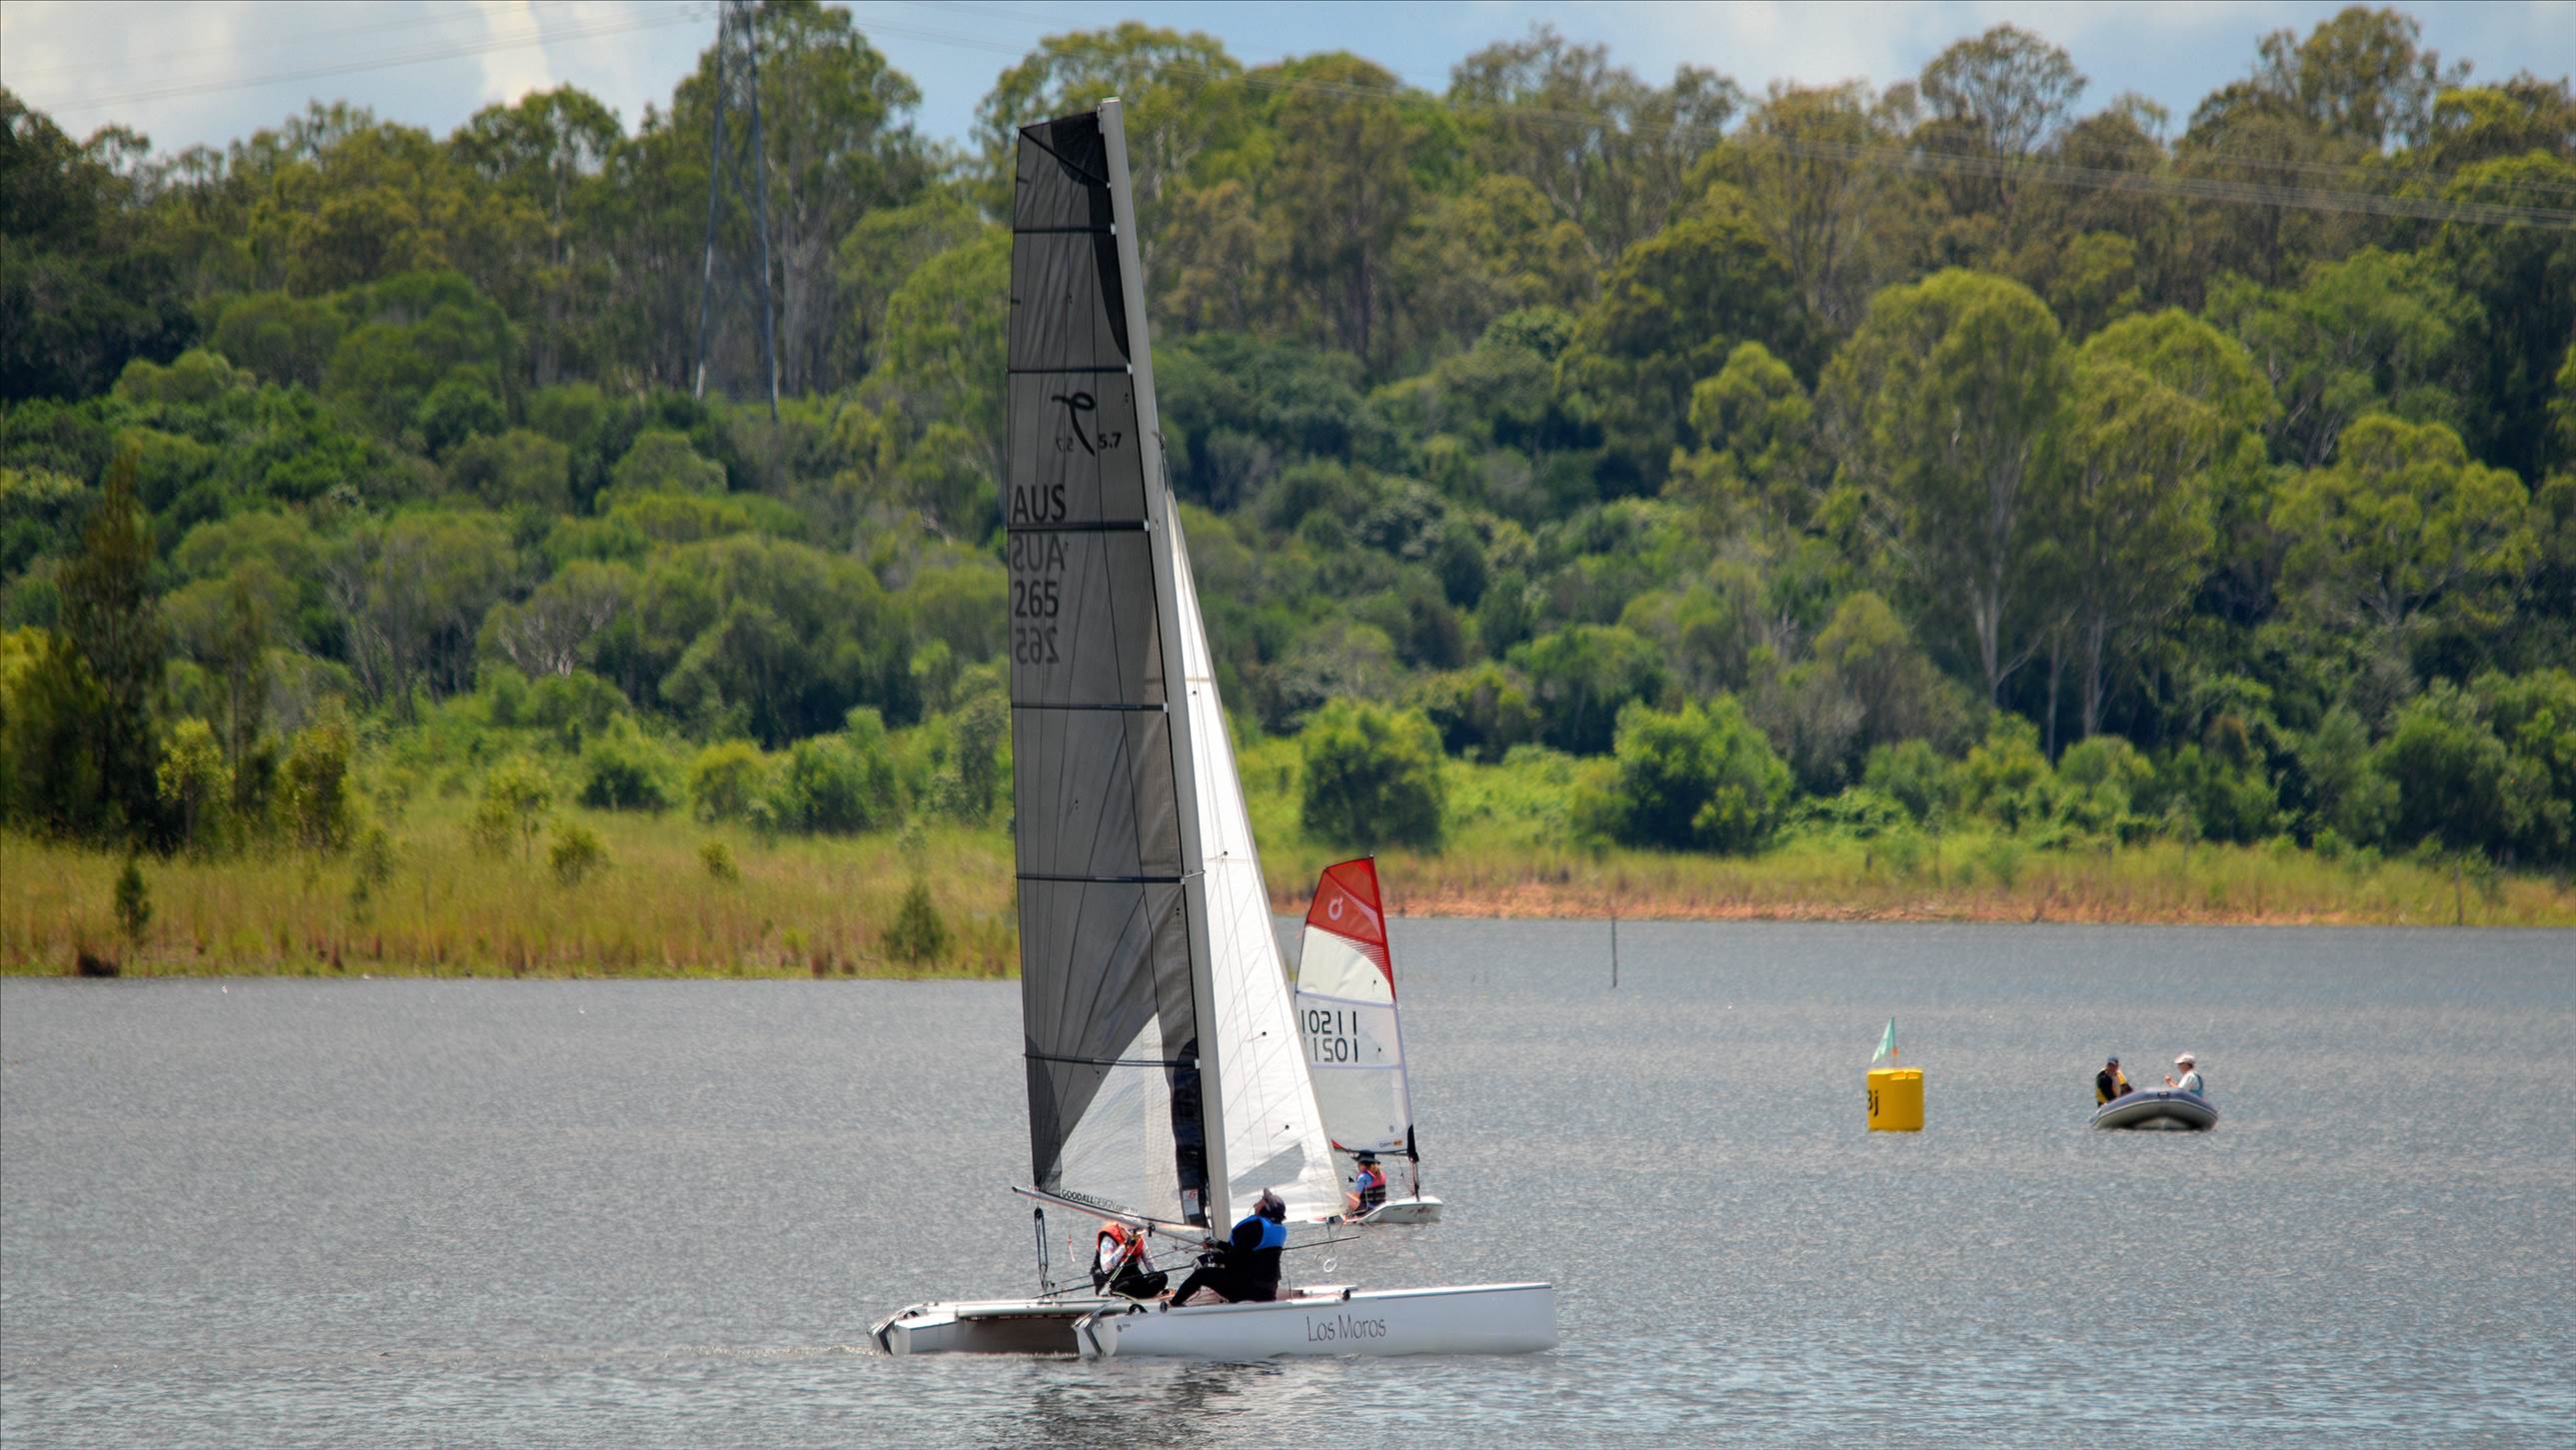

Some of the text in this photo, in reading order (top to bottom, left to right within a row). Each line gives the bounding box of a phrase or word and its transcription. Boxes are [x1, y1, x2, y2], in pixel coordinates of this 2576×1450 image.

[1099, 431, 1122, 450] 5.7
[1012, 484, 1067, 523] AUS
[1014, 580, 1060, 619] 265
[1300, 1009, 1357, 1036] 10211
[1305, 1314, 1386, 1342] Los Moros
